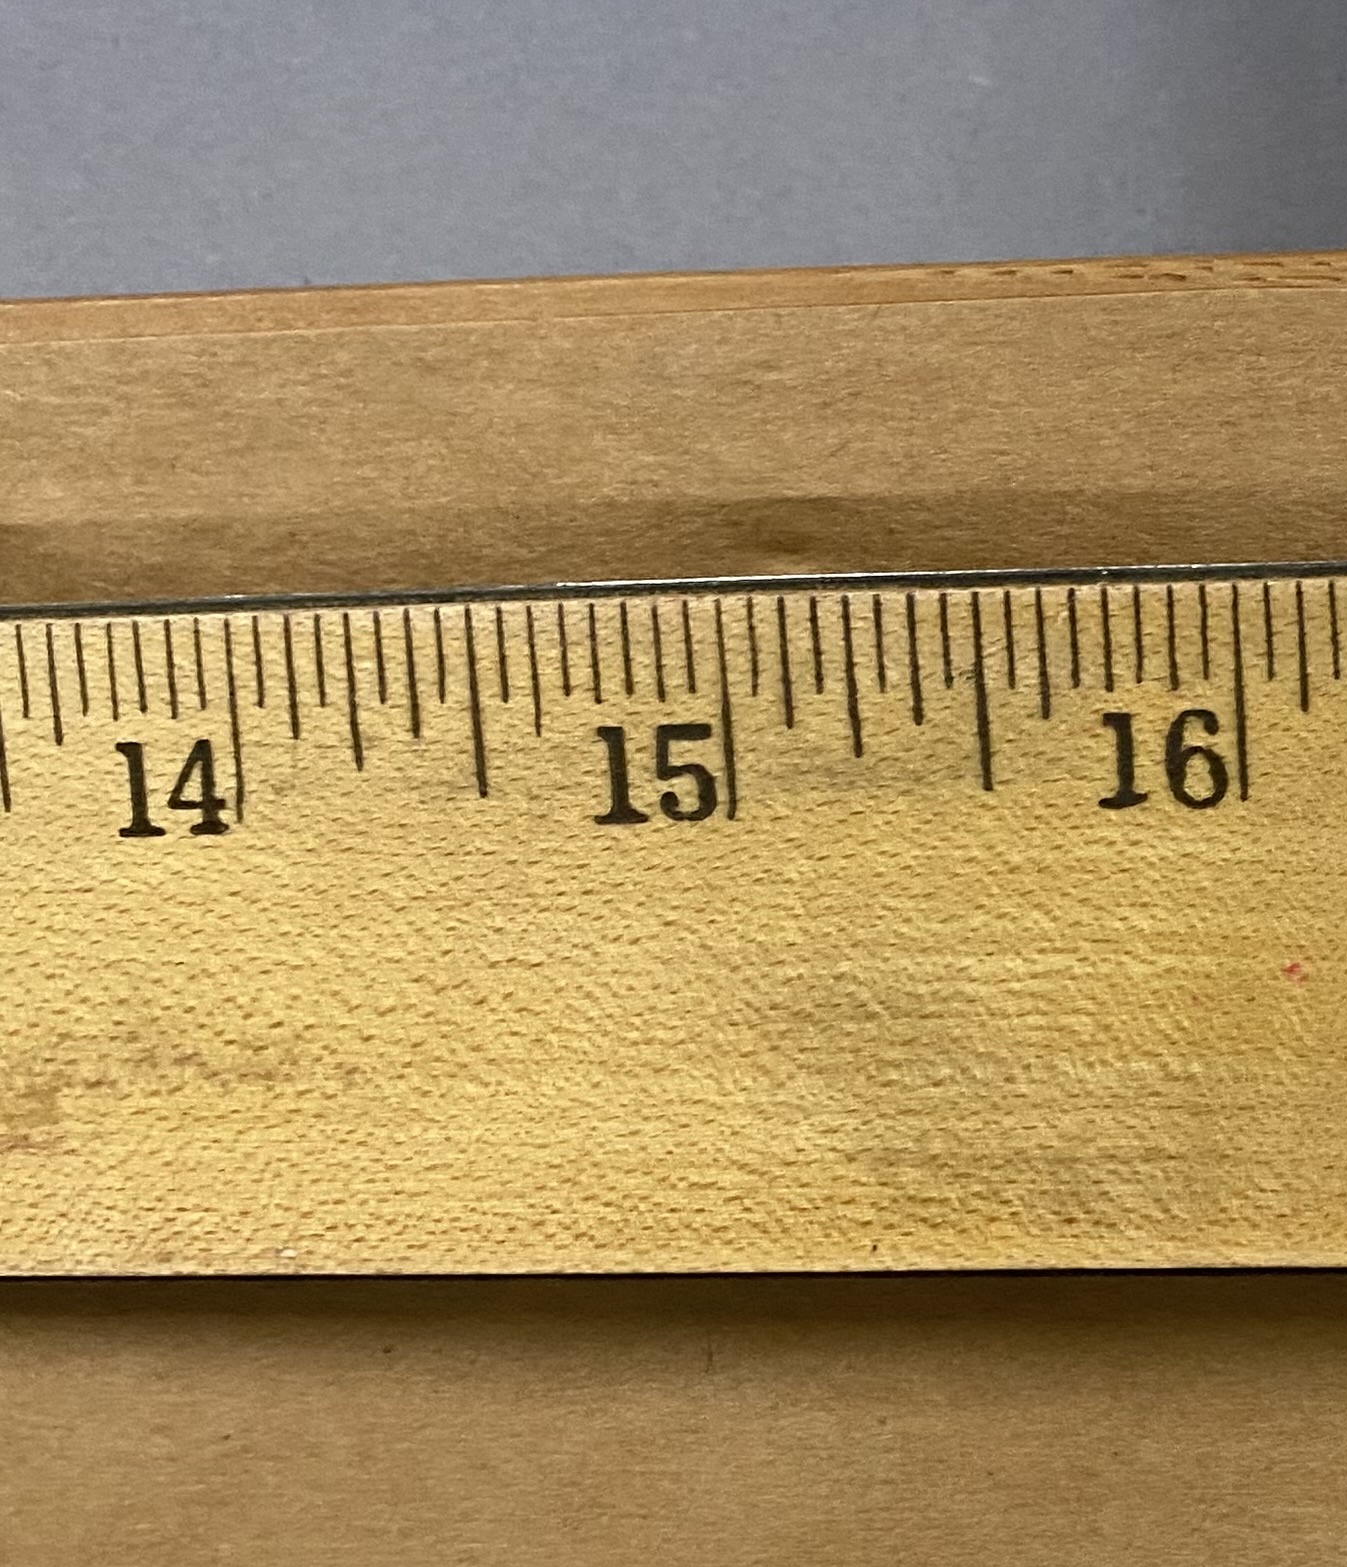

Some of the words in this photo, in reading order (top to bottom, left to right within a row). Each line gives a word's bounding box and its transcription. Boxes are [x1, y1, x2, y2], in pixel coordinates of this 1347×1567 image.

[115, 739, 230, 838] 14
[594, 723, 718, 826] 15
[1098, 708, 1229, 810] 16
